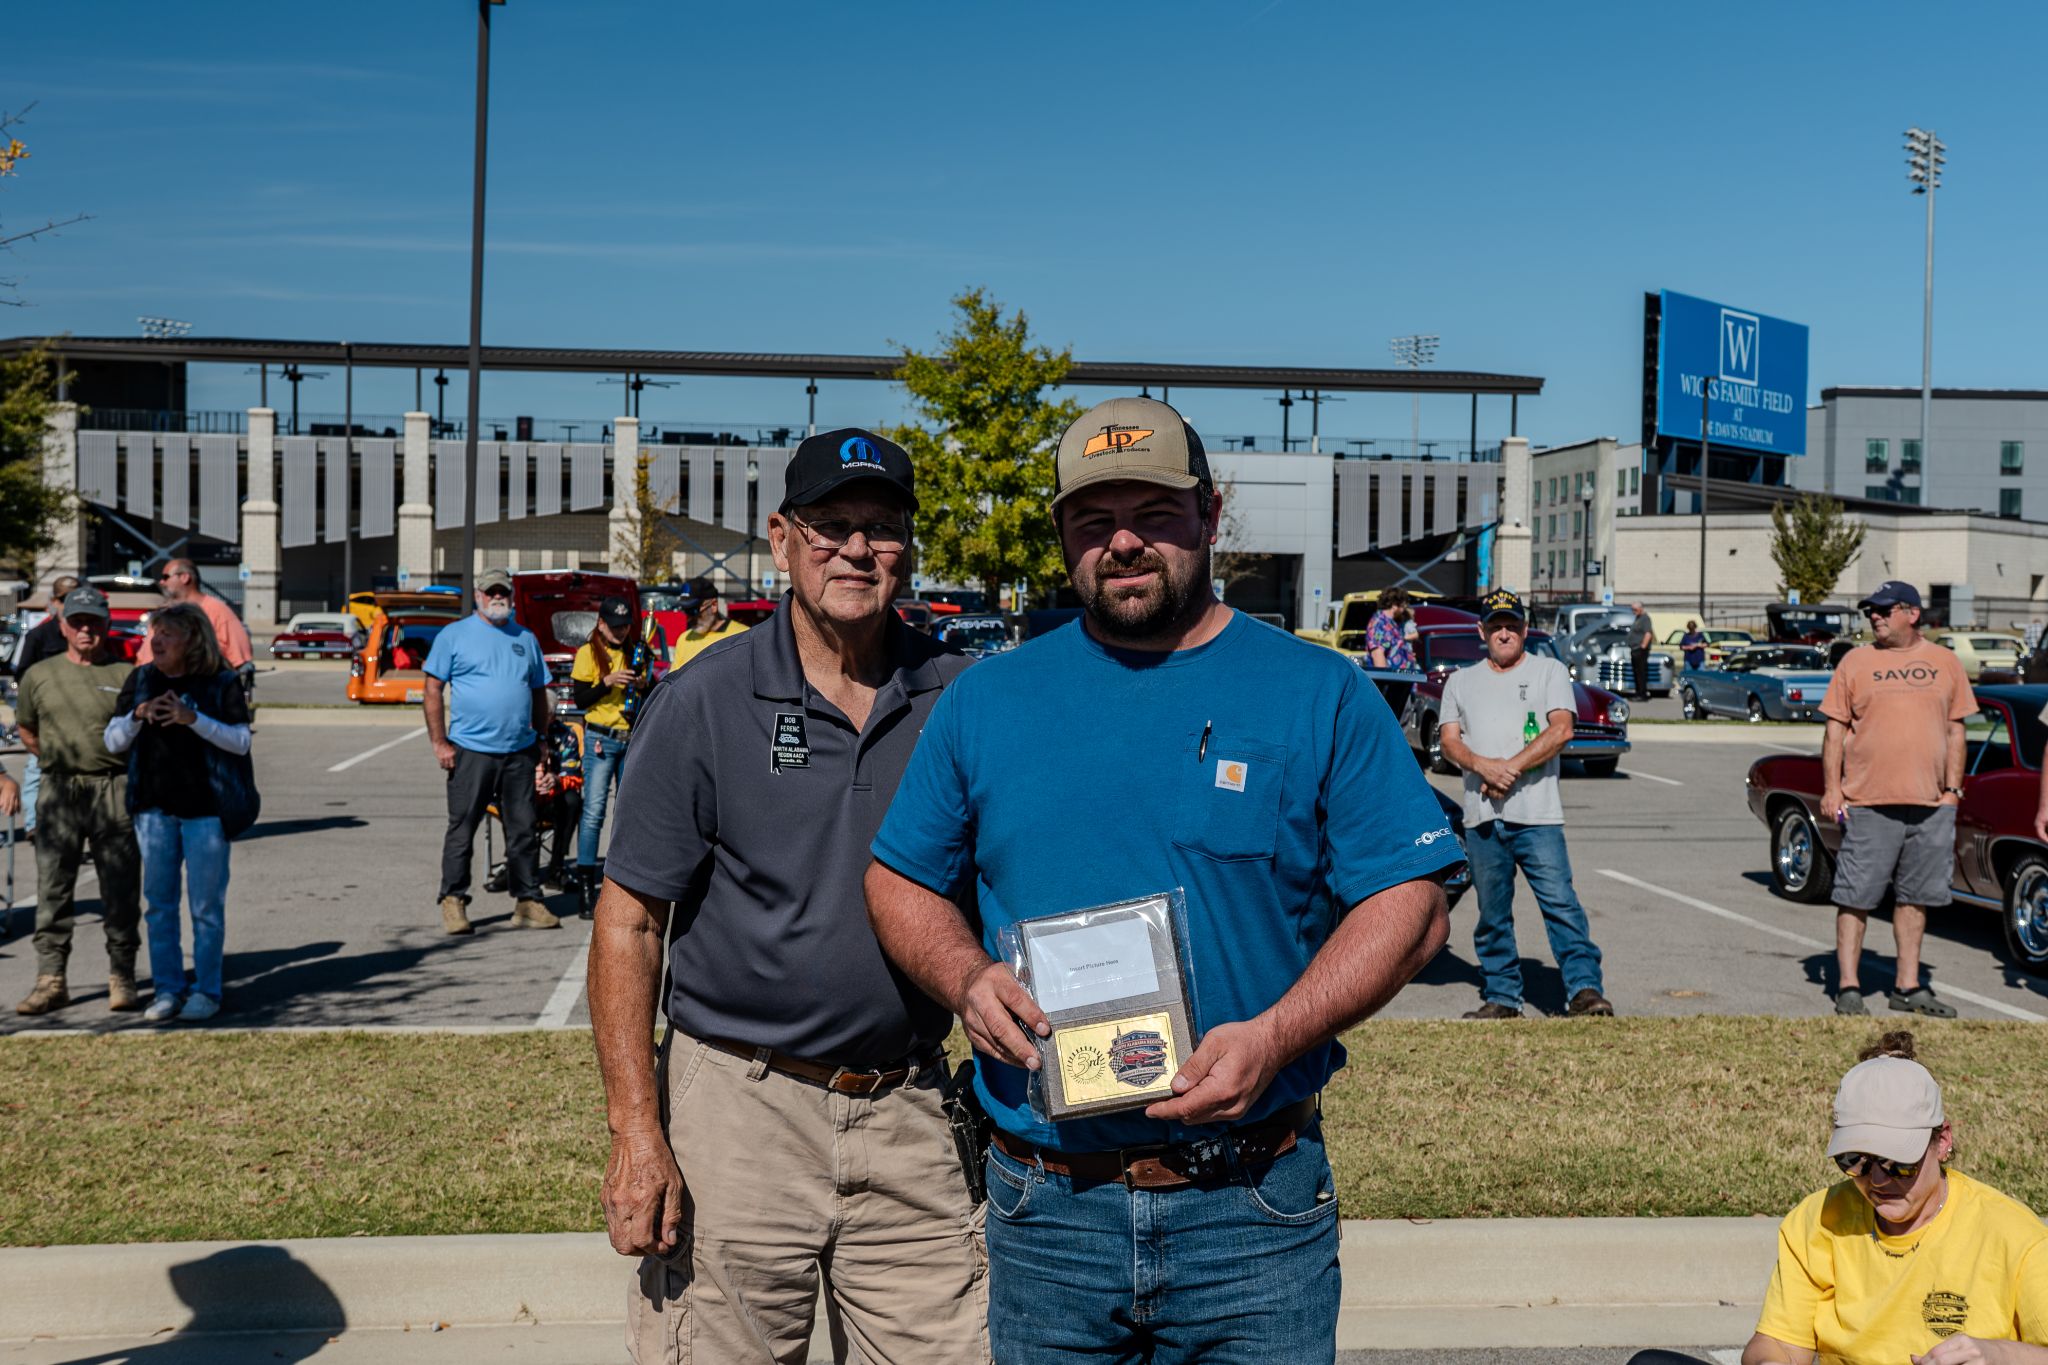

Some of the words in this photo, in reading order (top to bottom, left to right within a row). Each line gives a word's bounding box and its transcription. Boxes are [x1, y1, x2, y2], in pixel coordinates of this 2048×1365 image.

[1725, 320, 1755, 373] W
[1721, 381, 1761, 408] FAMILY
[1763, 389, 1793, 414] FIELD
[1733, 407, 1744, 422] AT
[1715, 421, 1738, 439] DAVIS
[1739, 427, 1773, 445] STADIUM
[841, 461, 886, 472] MOPAR
[1873, 668, 1938, 681] SAVOY
[1415, 827, 1451, 847] FORCE
[1074, 1052, 1101, 1078] 3rd
